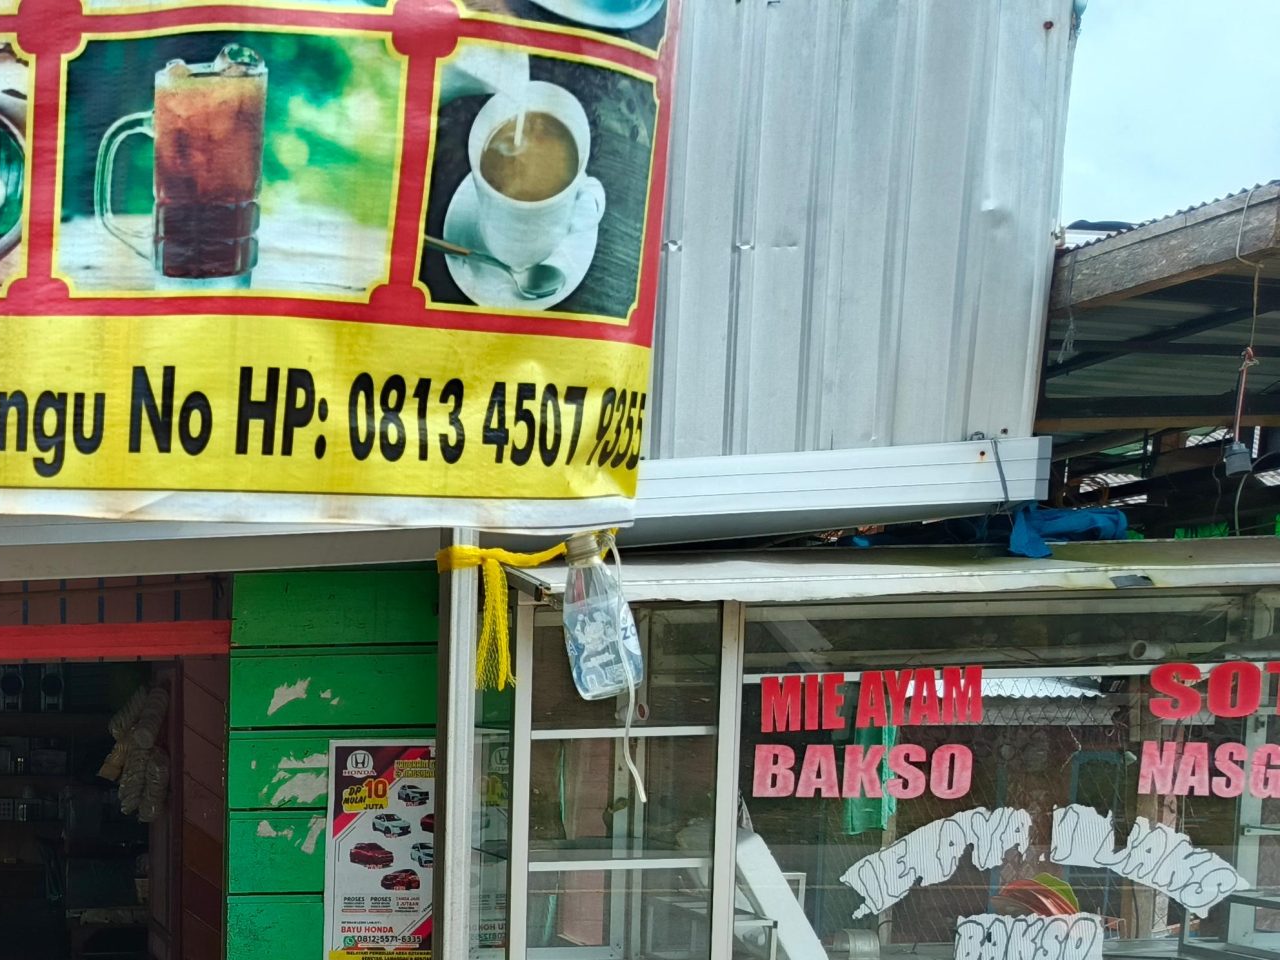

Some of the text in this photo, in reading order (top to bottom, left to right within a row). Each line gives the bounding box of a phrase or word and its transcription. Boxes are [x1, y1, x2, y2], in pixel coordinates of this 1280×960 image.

[128, 365, 213, 457] No
[234, 366, 329, 460] HP:
[348, 371, 466, 465] 0813
[481, 381, 589, 468] 4507
[586, 387, 647, 471] 9355
[761, 665, 984, 733] MIE AYAM
[364, 779, 388, 799] 10
[752, 743, 973, 800] BAKSO
[341, 926, 394, 934] BAYU HONDA
